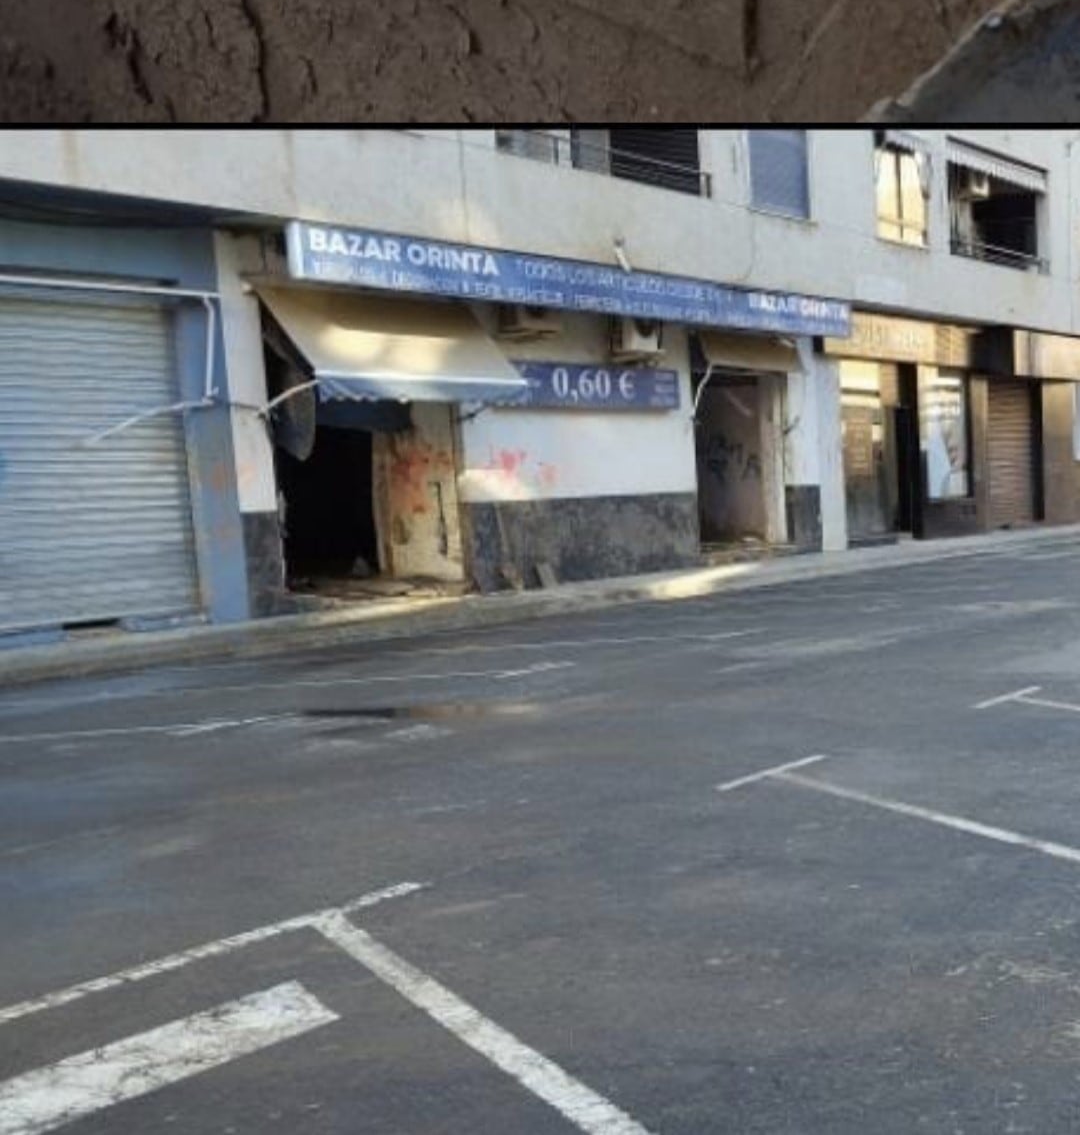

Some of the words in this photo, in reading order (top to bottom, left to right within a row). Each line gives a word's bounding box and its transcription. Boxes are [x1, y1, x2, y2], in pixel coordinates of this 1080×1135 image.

[309, 228, 400, 263] BAZAR
[407, 244, 499, 275] ORINTA
[749, 292, 799, 313] BAZAR
[552, 367, 611, 402] 0,60
[618, 369, 638, 400] €
